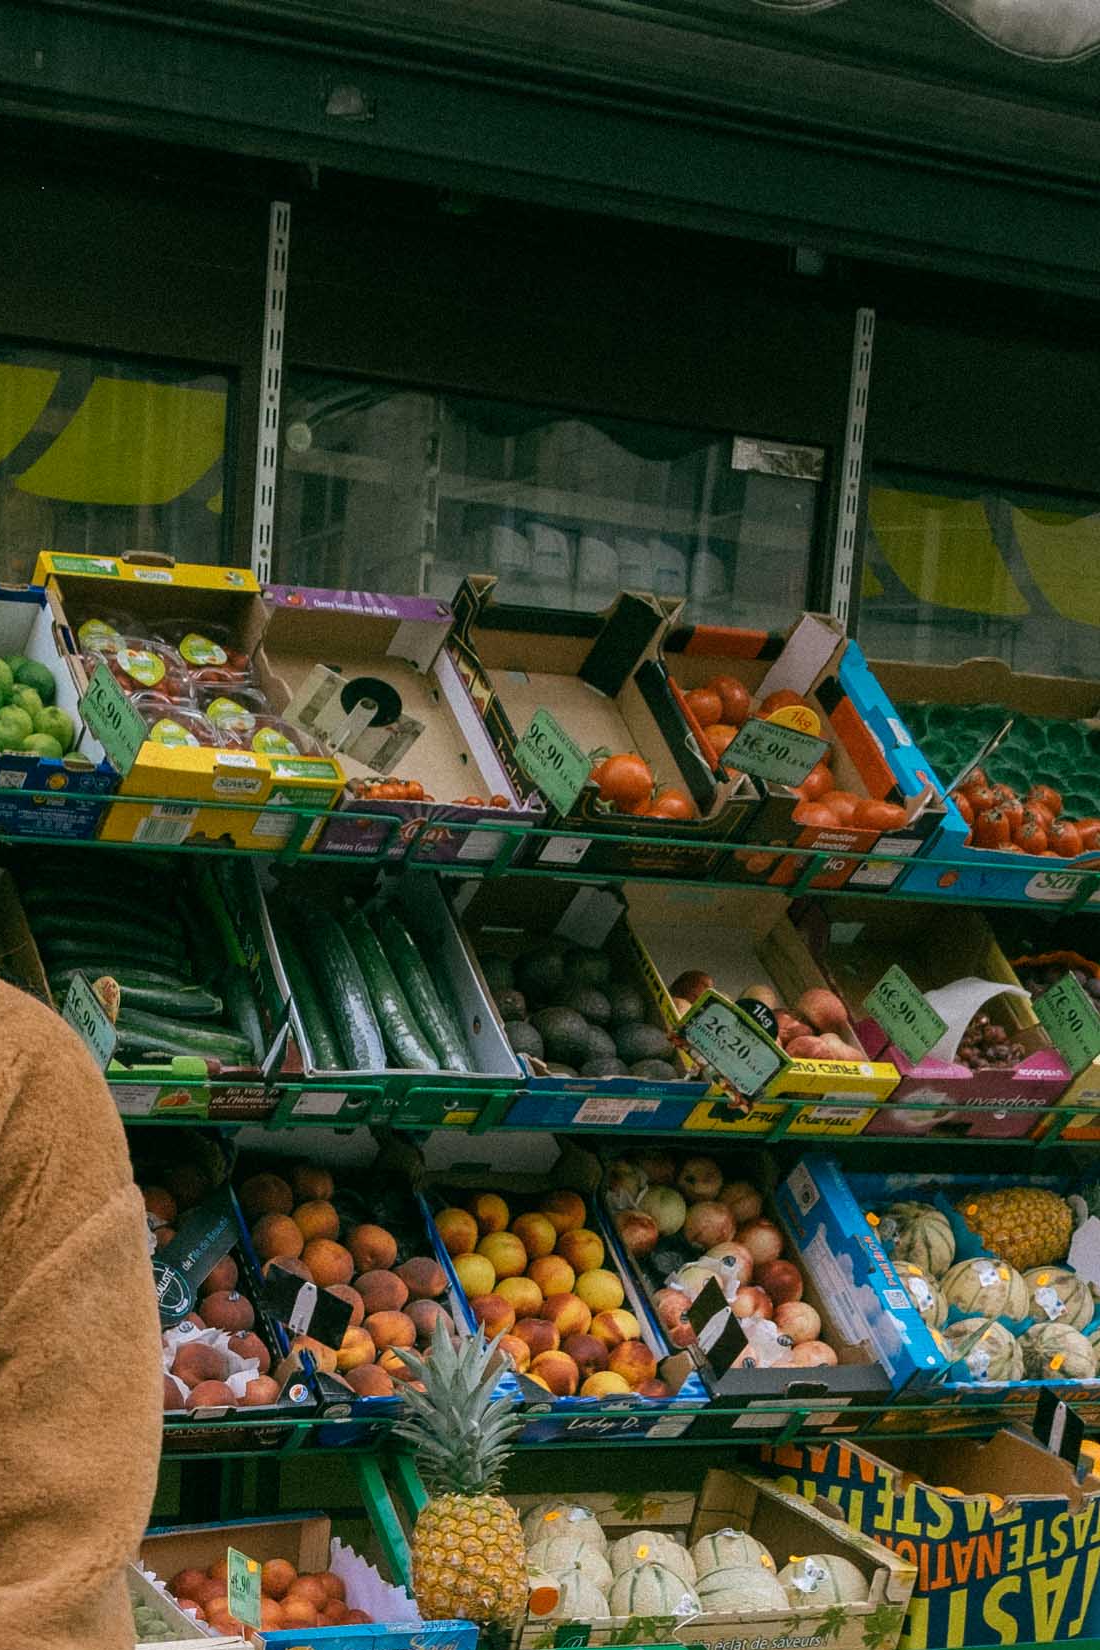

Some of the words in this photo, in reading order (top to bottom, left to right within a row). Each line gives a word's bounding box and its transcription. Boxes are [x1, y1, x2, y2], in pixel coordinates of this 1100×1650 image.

[91, 678, 122, 730] 7€.90
[528, 723, 564, 770] 9€.90
[742, 732, 790, 761] 3€.90
[67, 986, 96, 1037] 3€.90
[752, 1003, 773, 1030] 1kg
[879, 982, 917, 1025] 6€.90
[1051, 985, 1084, 1032] 7€.90
[704, 1015, 751, 1059] 2€.20
[243, 1087, 279, 1096] Vergrs
[566, 1416, 616, 1433] Lady
[620, 1416, 640, 1430] D.
[874, 1530, 1004, 1592] NATIO
[751, 1634, 769, 1650] de
[771, 1635, 822, 1649] saveurs
